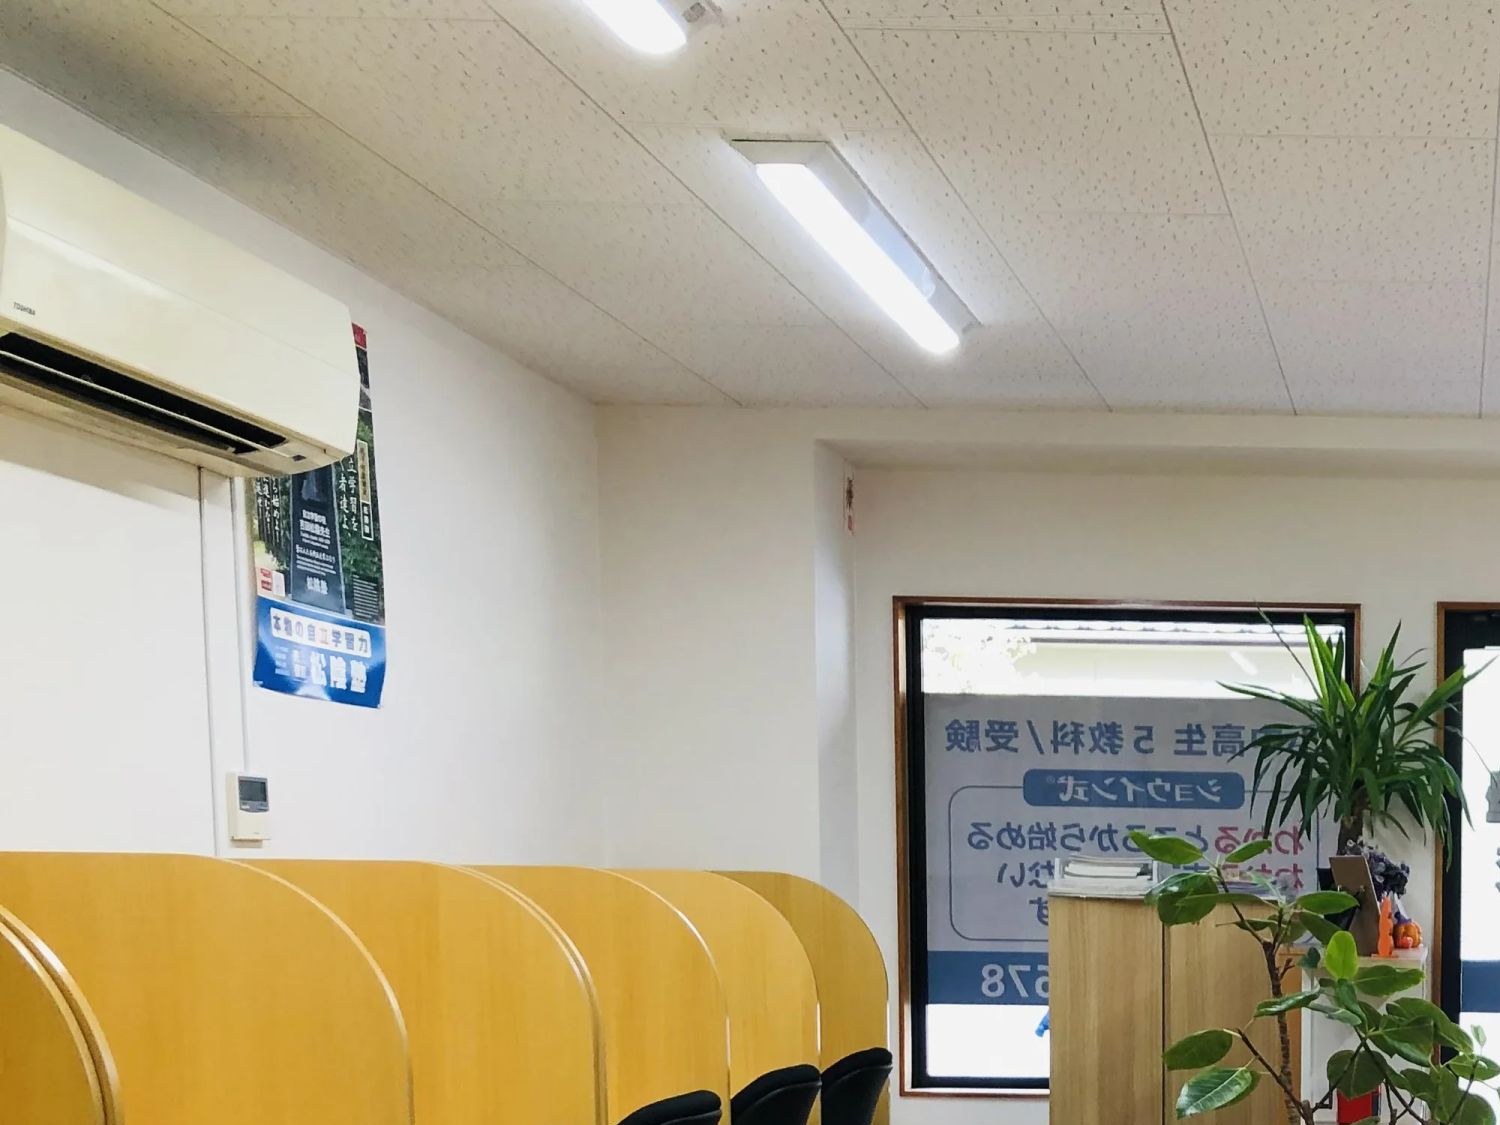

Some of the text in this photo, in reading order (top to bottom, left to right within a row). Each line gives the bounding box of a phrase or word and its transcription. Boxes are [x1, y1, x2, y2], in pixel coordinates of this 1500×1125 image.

[273, 613, 368, 655] 本物の自立学習力
[310, 651, 367, 694] 松陰塾
